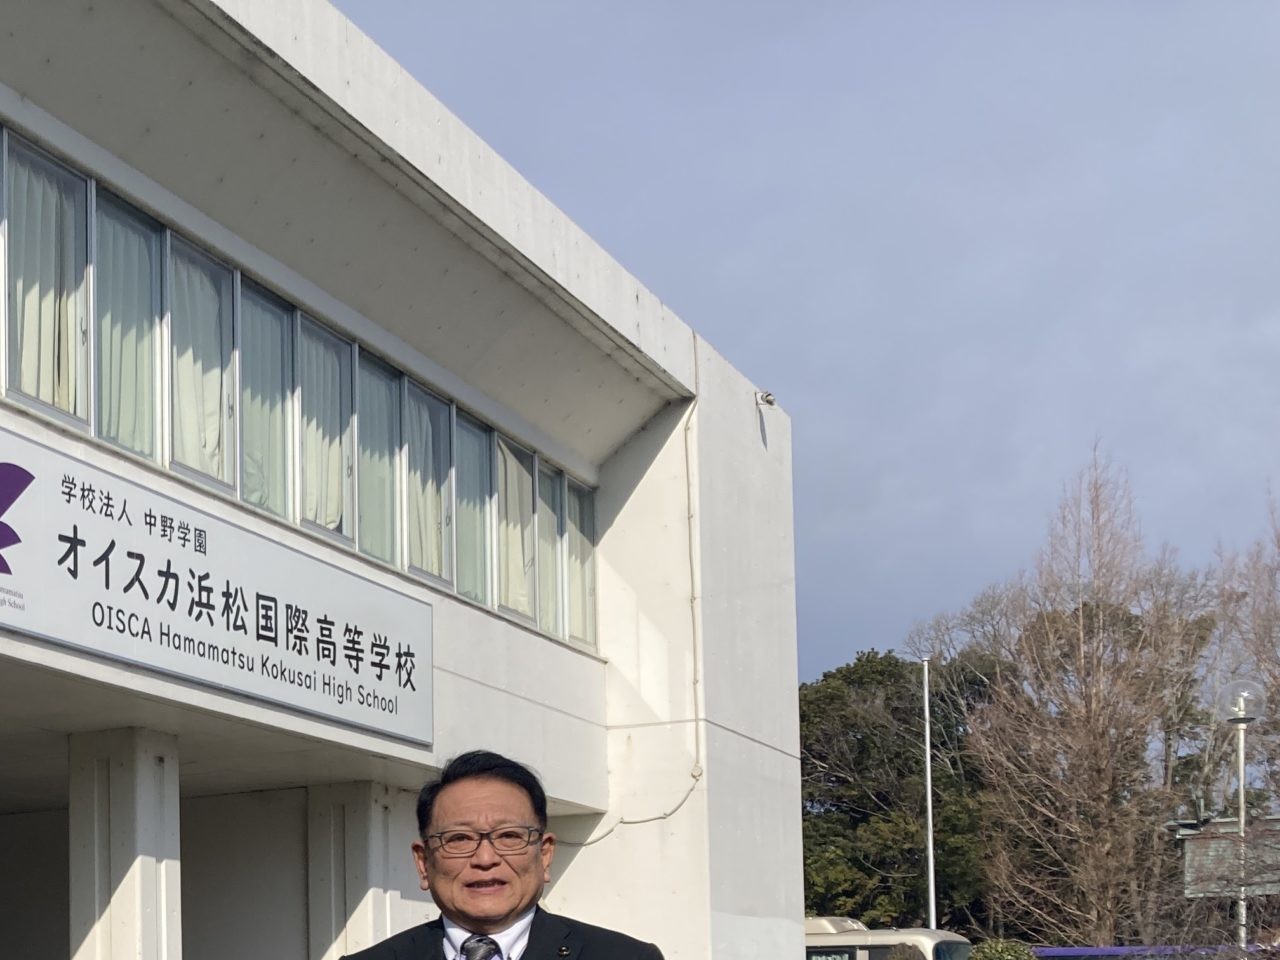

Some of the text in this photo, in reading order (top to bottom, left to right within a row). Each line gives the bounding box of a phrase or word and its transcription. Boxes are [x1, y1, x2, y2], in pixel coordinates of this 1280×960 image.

[61, 474, 208, 556] 学校法人 中野学園
[57, 524, 417, 693] オイスカ浜松国際高等学校
[92, 601, 399, 715] OISCA Hamamatsu Kokusai High School
